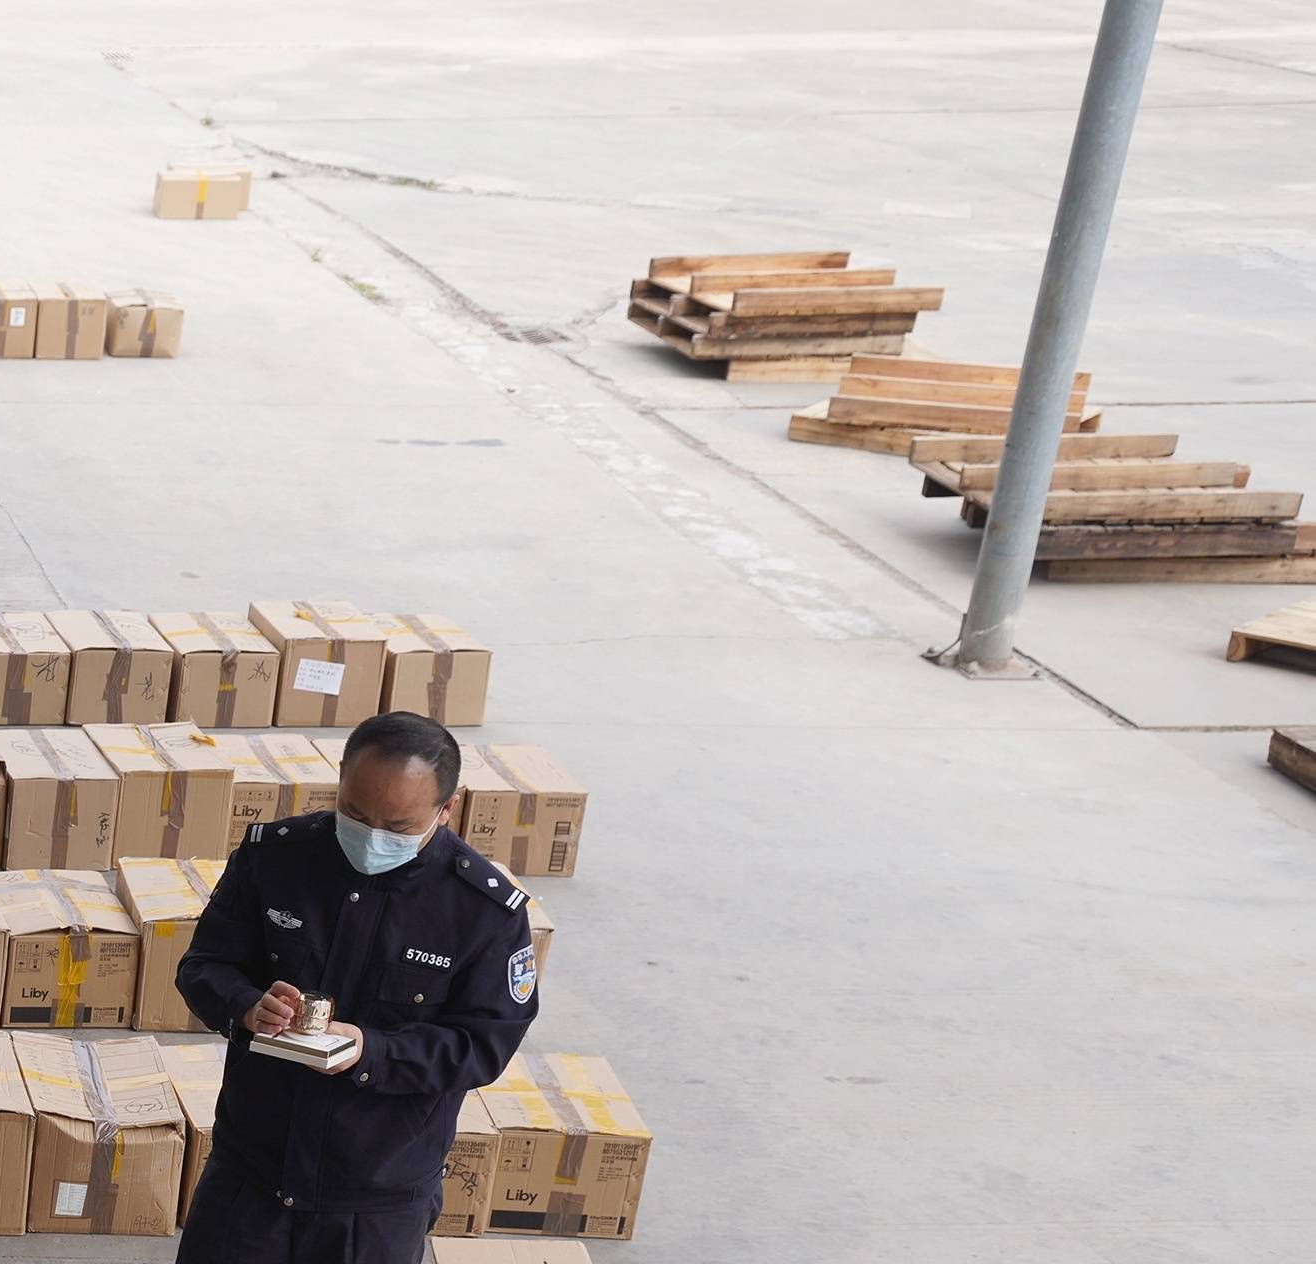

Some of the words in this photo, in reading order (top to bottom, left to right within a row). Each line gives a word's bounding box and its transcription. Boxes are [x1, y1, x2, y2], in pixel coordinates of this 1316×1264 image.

[233, 805, 262, 820] Liby
[472, 823, 497, 836] Liby
[406, 948, 452, 969] 570385
[22, 988, 48, 1001] Liby
[505, 1189, 537, 1205] Liby
